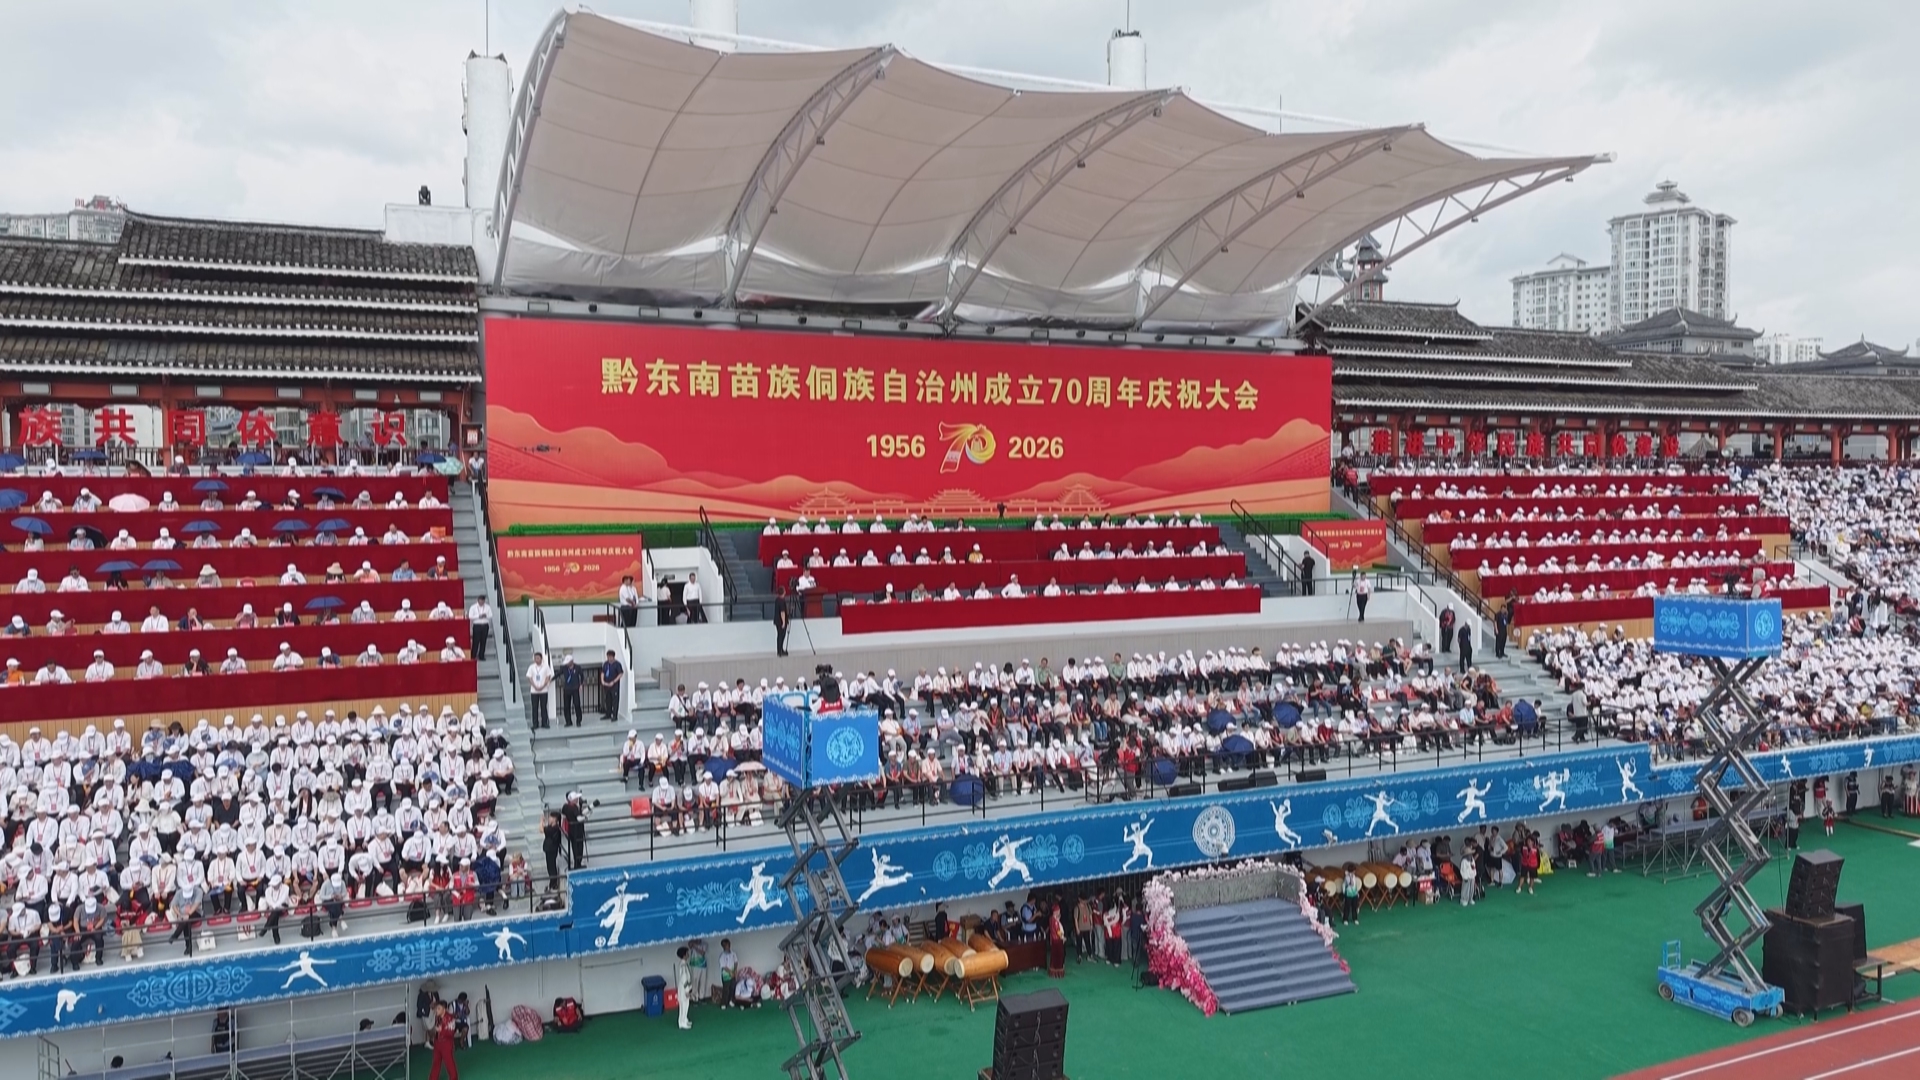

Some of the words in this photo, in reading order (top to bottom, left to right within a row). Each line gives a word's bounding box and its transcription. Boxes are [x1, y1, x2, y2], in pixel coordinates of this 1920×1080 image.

[601, 357, 1260, 411] 黔东南苗族侗族自治州成立70周年庆祝大会
[18, 409, 407, 446] 族共同体意识
[867, 434, 926, 458] 1956
[1008, 436, 1064, 459] 2026
